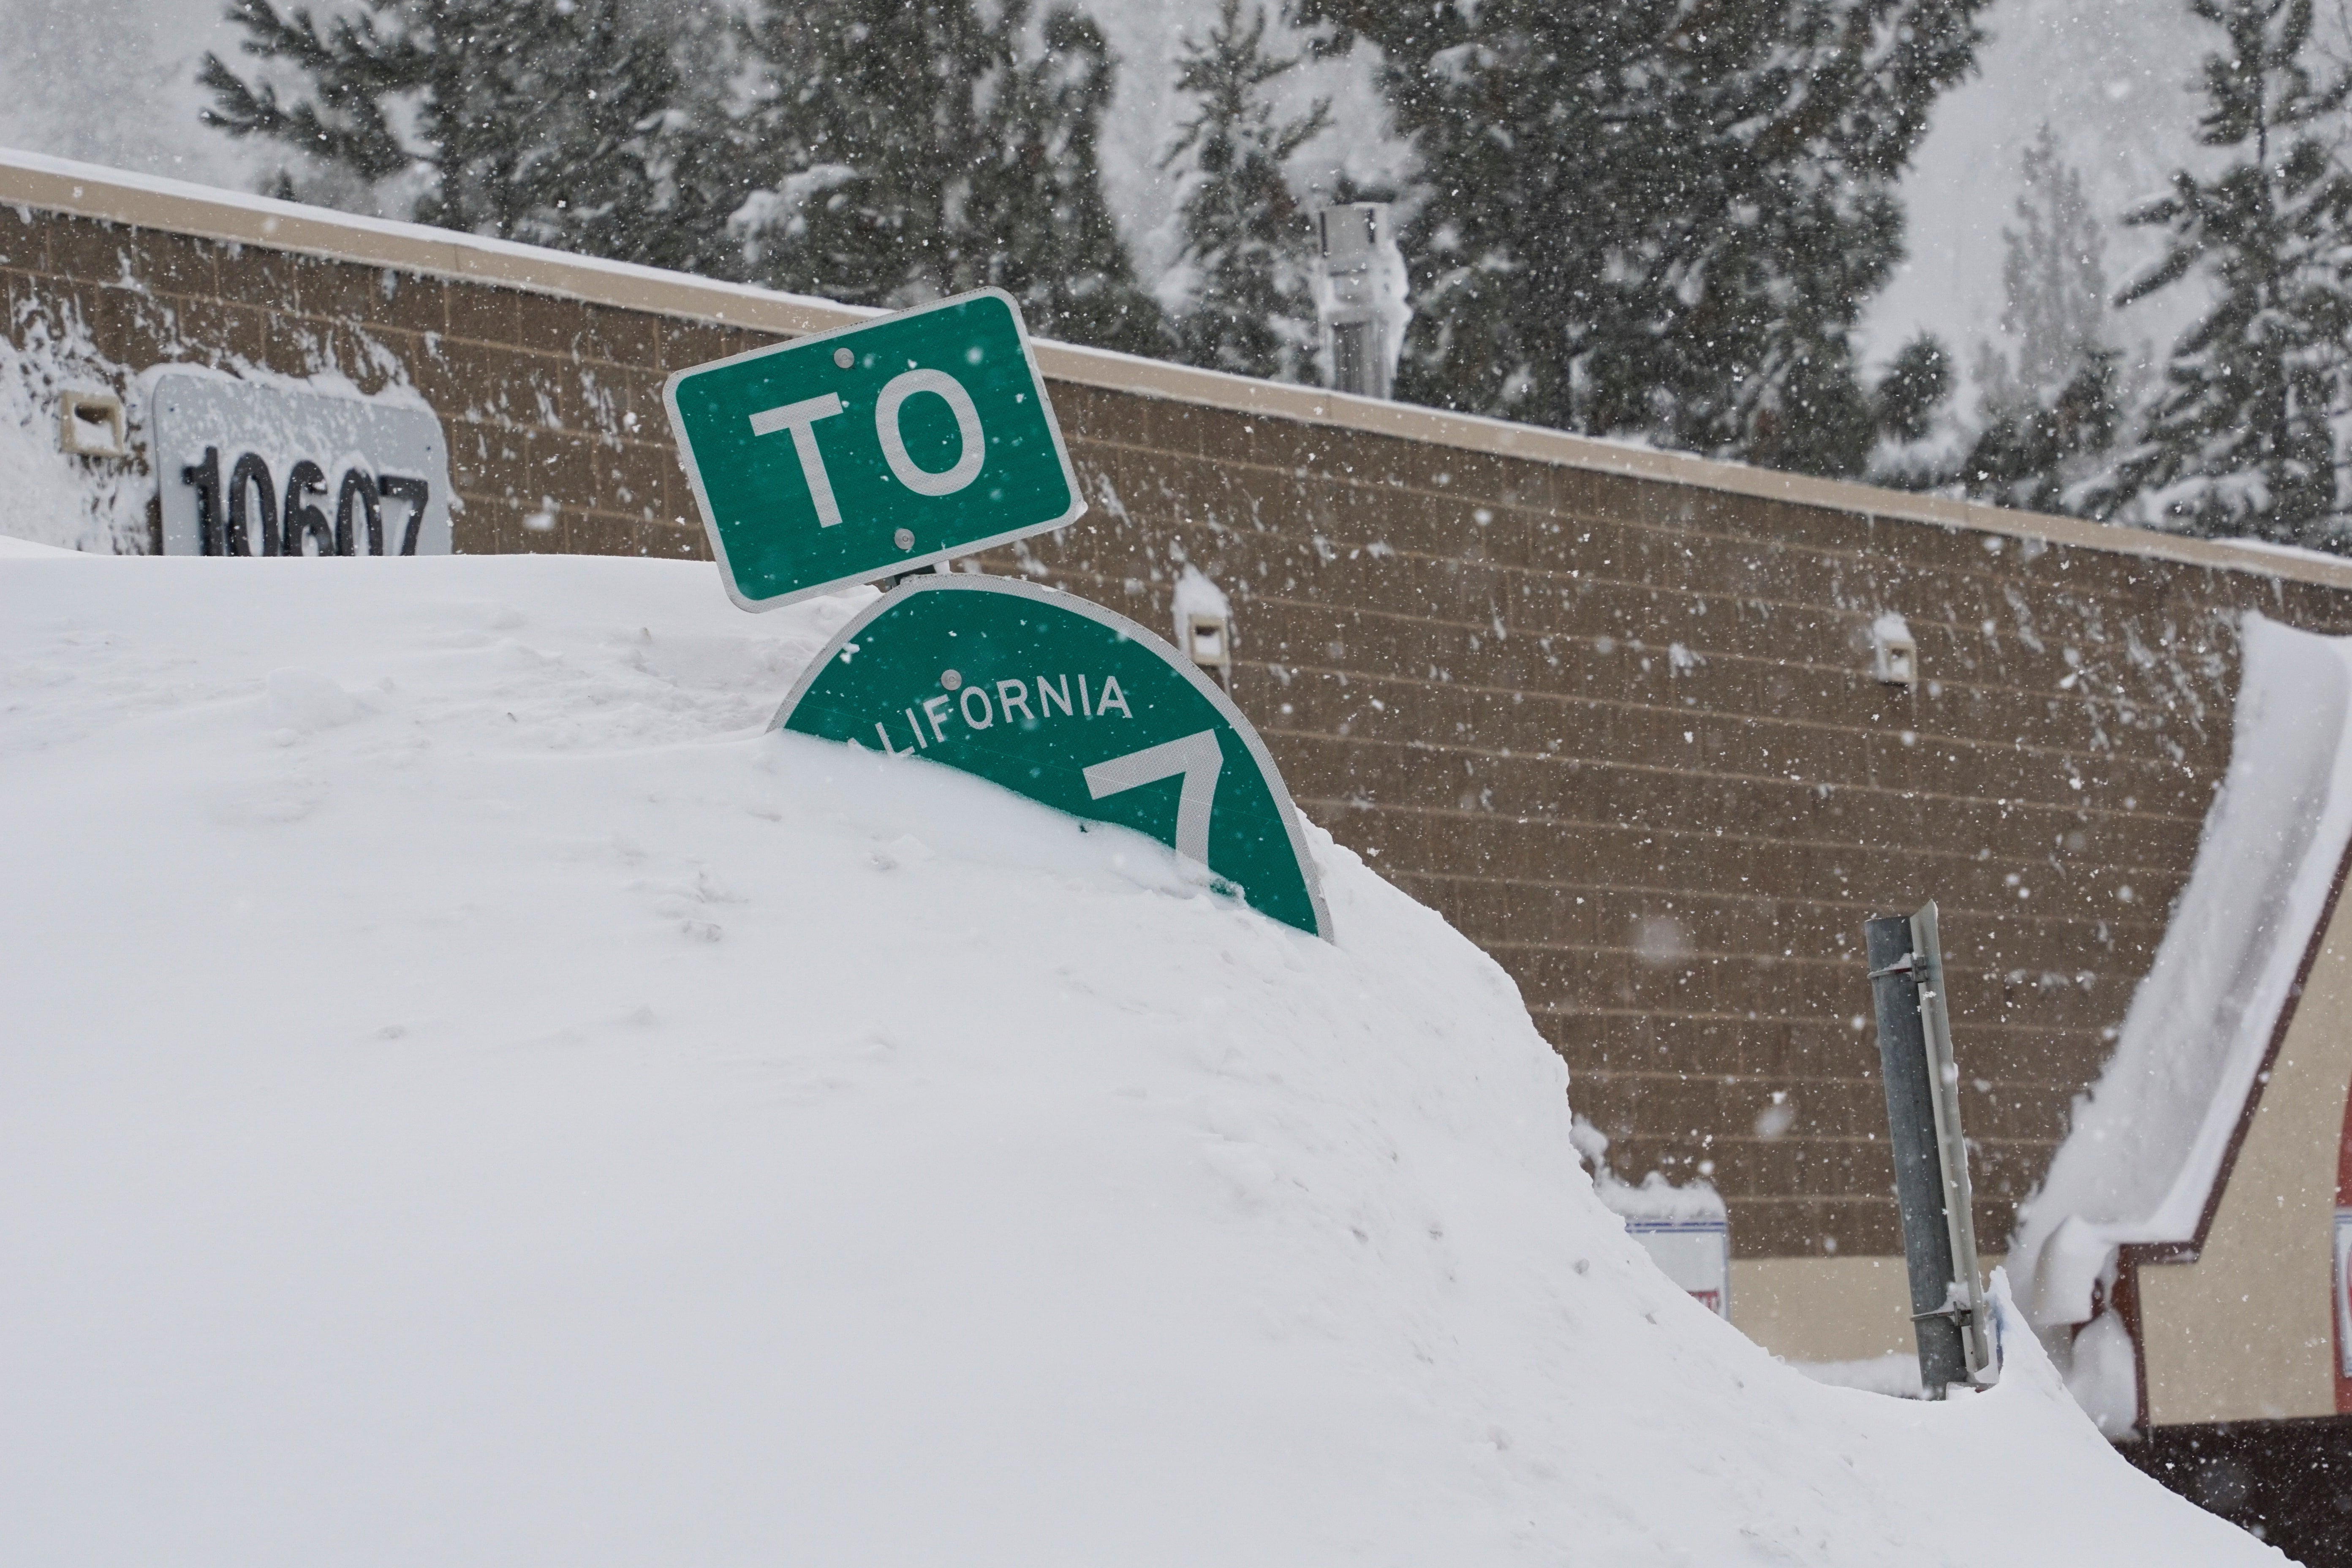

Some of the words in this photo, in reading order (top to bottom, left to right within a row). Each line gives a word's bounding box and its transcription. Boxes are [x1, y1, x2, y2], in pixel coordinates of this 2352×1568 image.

[182, 446, 428, 557] 10607
[749, 369, 985, 528] TO
[848, 674, 1133, 757] LIFORNIA
[1082, 728, 1224, 868] 7
